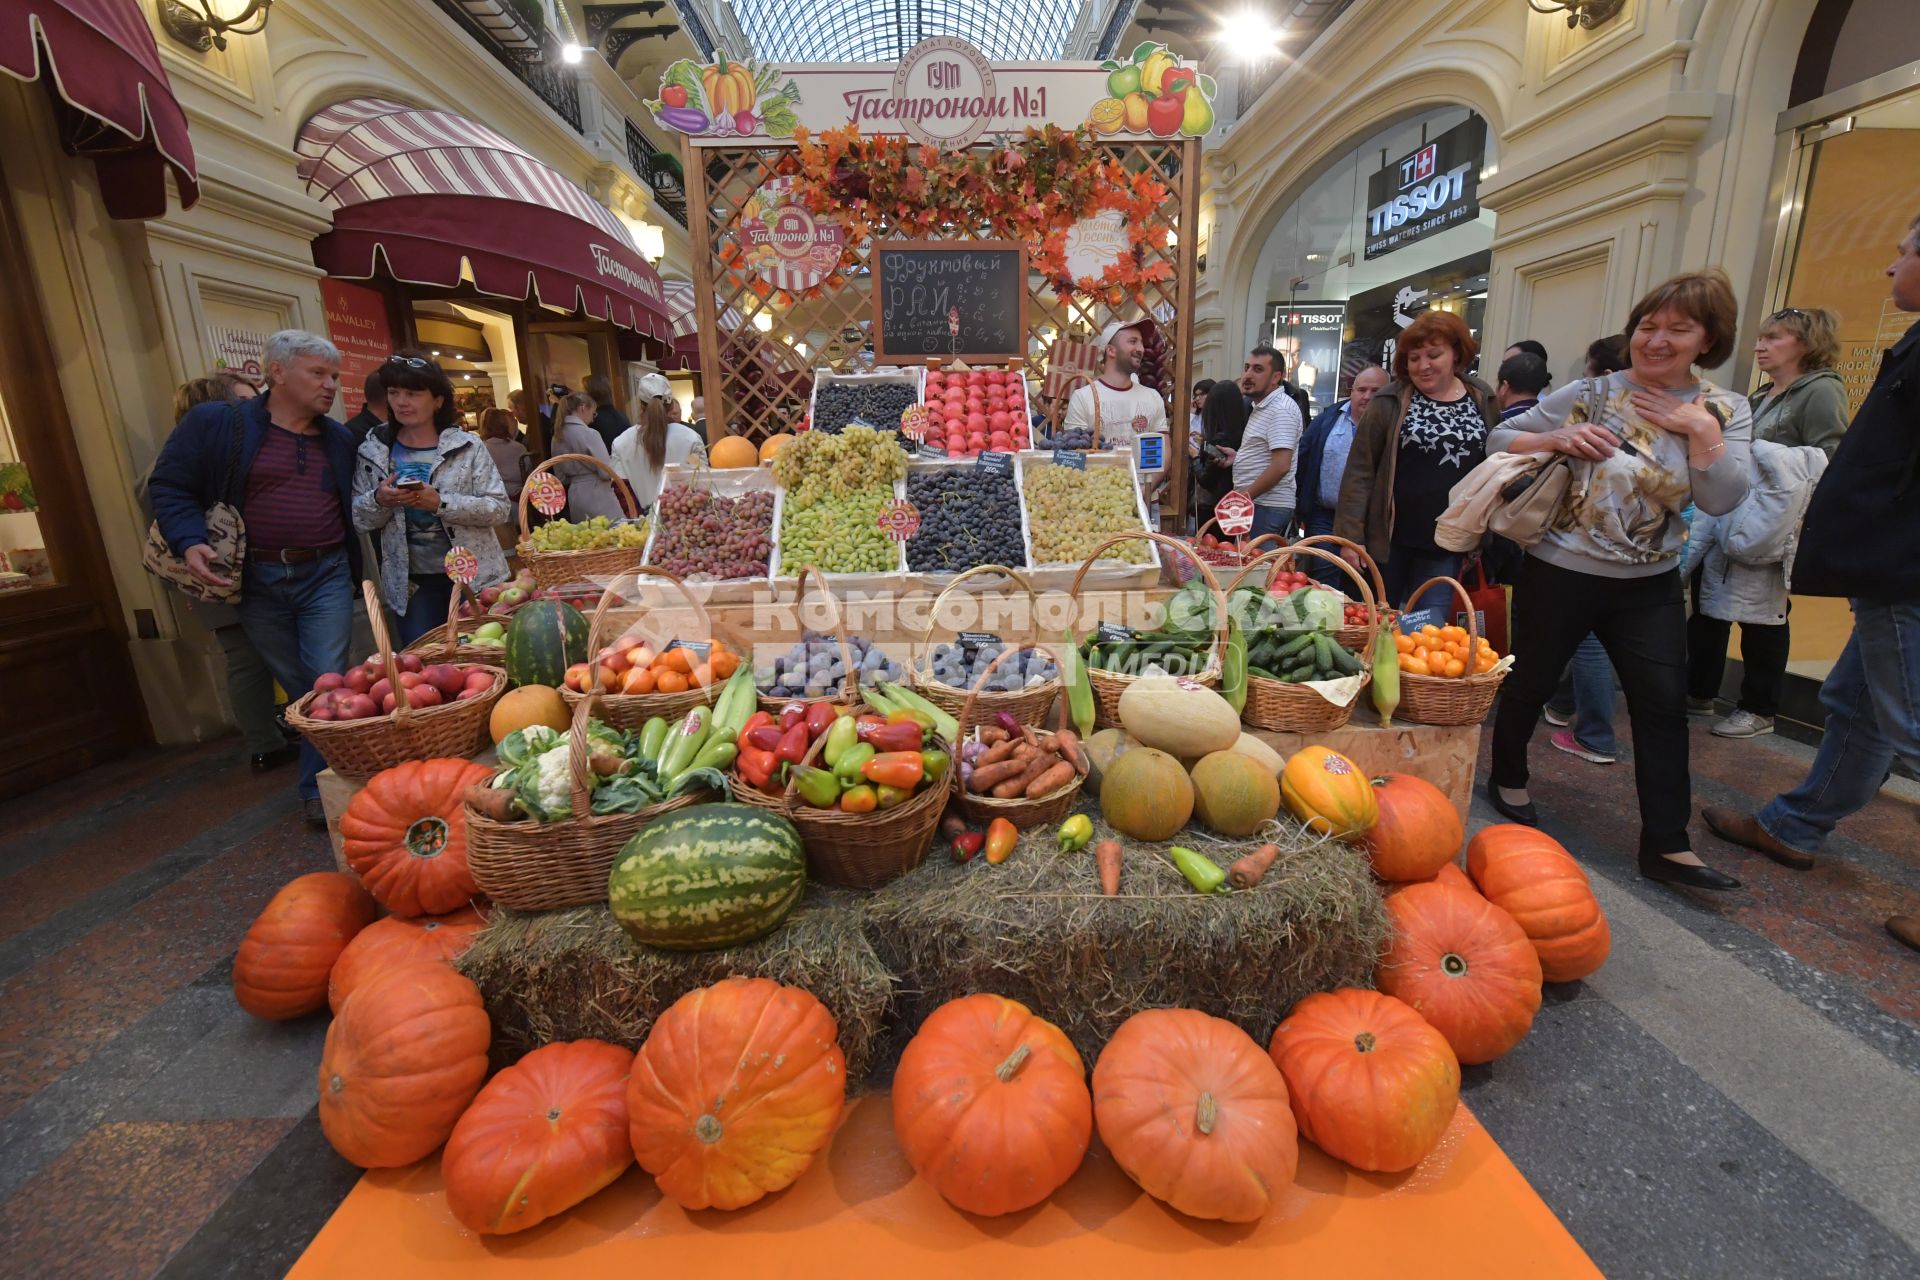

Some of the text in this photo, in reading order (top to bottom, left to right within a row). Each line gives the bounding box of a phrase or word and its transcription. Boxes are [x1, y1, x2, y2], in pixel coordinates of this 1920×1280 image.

[896, 39, 993, 87] КОМБИНАТ ХОРОШЕГО
[926, 60, 961, 91] ГУМ
[843, 86, 1047, 124] Гастроном №1
[1368, 161, 1472, 237] TISSOT
[750, 228, 818, 245] Гастроном
[1366, 205, 1468, 254] SWISS WATCHES SINCE 1853
[589, 243, 655, 298] Гастроном
[885, 254, 1001, 283] Фруктовый
[884, 280, 950, 320] РАЙ
[1301, 314, 1343, 324] TISSOT
[1836, 361, 1855, 371] RIO
